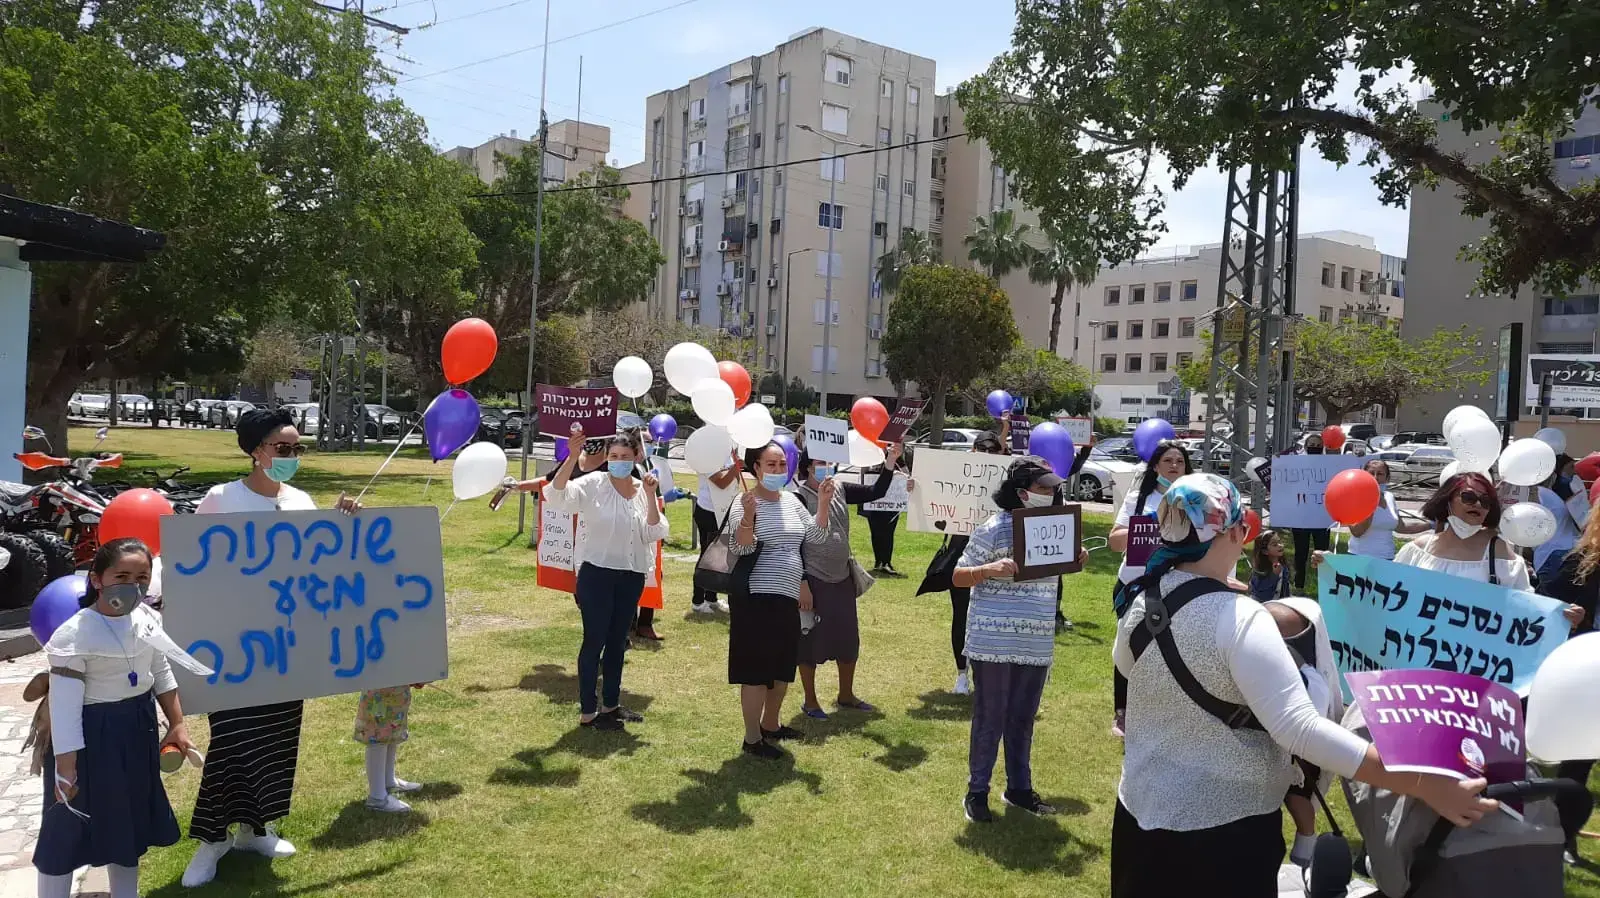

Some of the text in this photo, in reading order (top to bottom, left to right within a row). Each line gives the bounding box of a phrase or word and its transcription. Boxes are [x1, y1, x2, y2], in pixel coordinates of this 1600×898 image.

[542, 392, 612, 406] לא שכירות
[542, 404, 612, 418] לא עצמאיות
[809, 428, 845, 446] שביתה
[175, 516, 396, 576] שובתות
[1032, 523, 1066, 541] פרנסה
[1132, 536, 1163, 545] מאיות
[1133, 523, 1158, 533] ירות
[268, 571, 433, 618] כי מגיע
[1328, 571, 1546, 646] לא נסכים להיות
[186, 626, 296, 685] יותר
[329, 607, 399, 678] לנו
[1366, 684, 1516, 726] לא שכירות
[1376, 707, 1521, 756] לא עצמאיות
